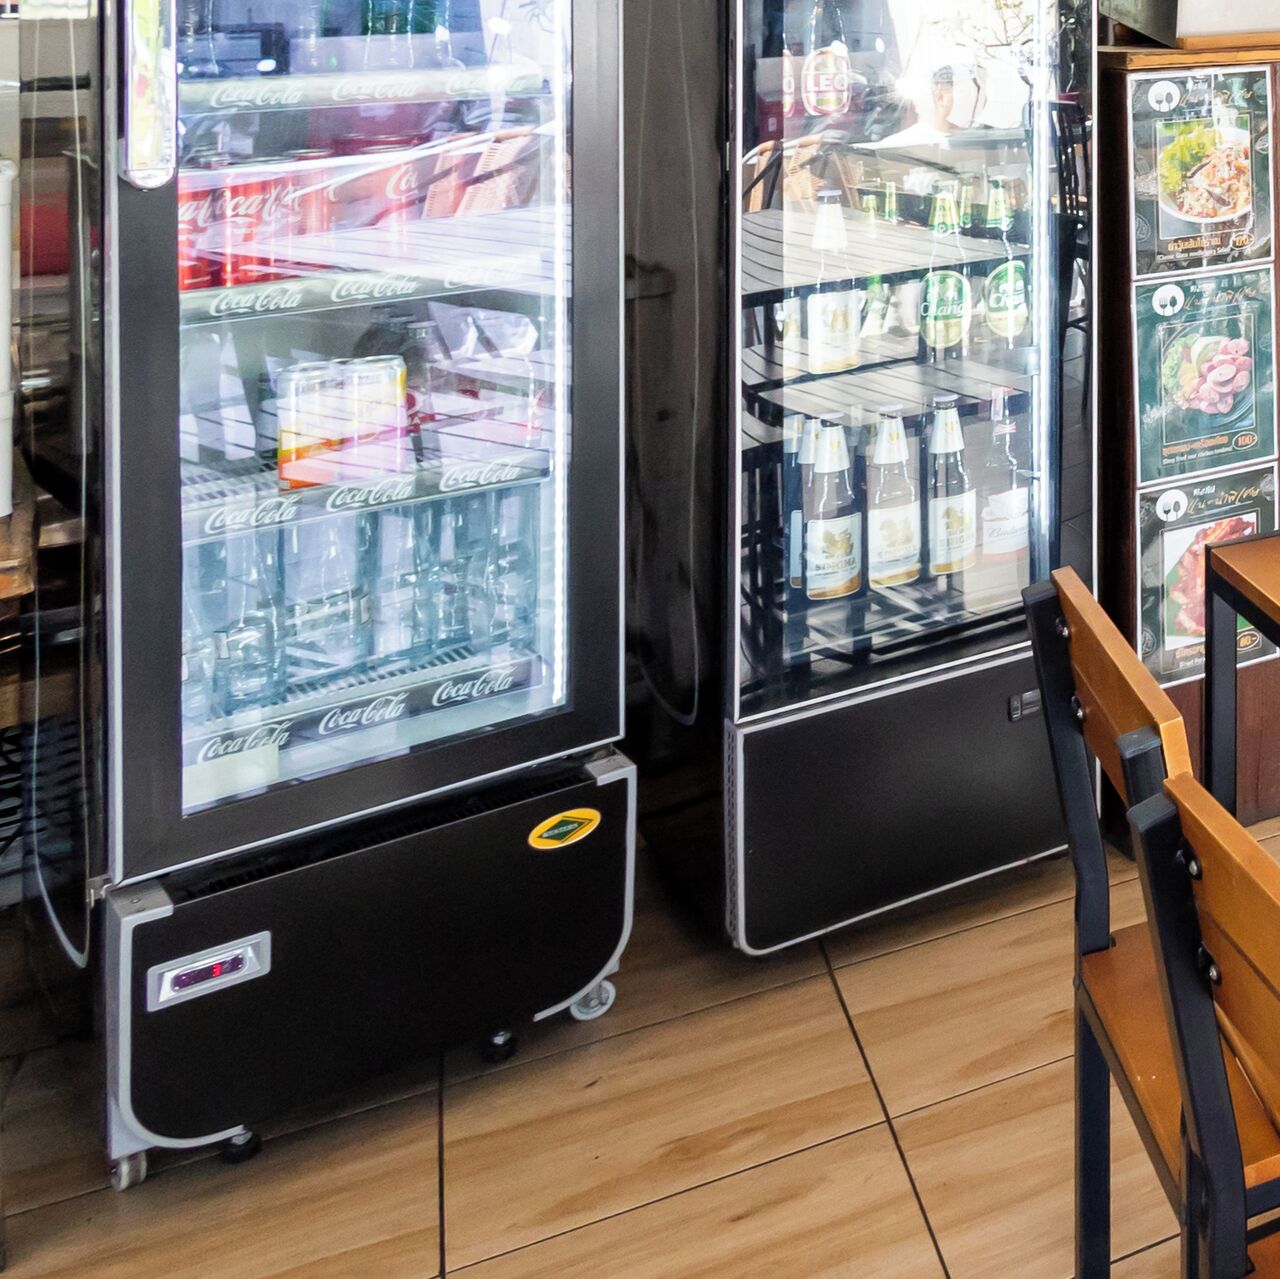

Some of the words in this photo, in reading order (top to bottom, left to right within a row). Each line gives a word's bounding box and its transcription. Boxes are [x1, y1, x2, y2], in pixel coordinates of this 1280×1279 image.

[209, 283, 304, 315] Coca-Cola
[325, 473, 418, 513] Coca-Cola
[438, 454, 528, 493] Coca-Cola
[203, 493, 303, 535] Coca-Cola
[432, 665, 518, 707] Coca-Cola
[318, 690, 410, 735] Coca-Cola
[211, 963, 221, 977] 3
